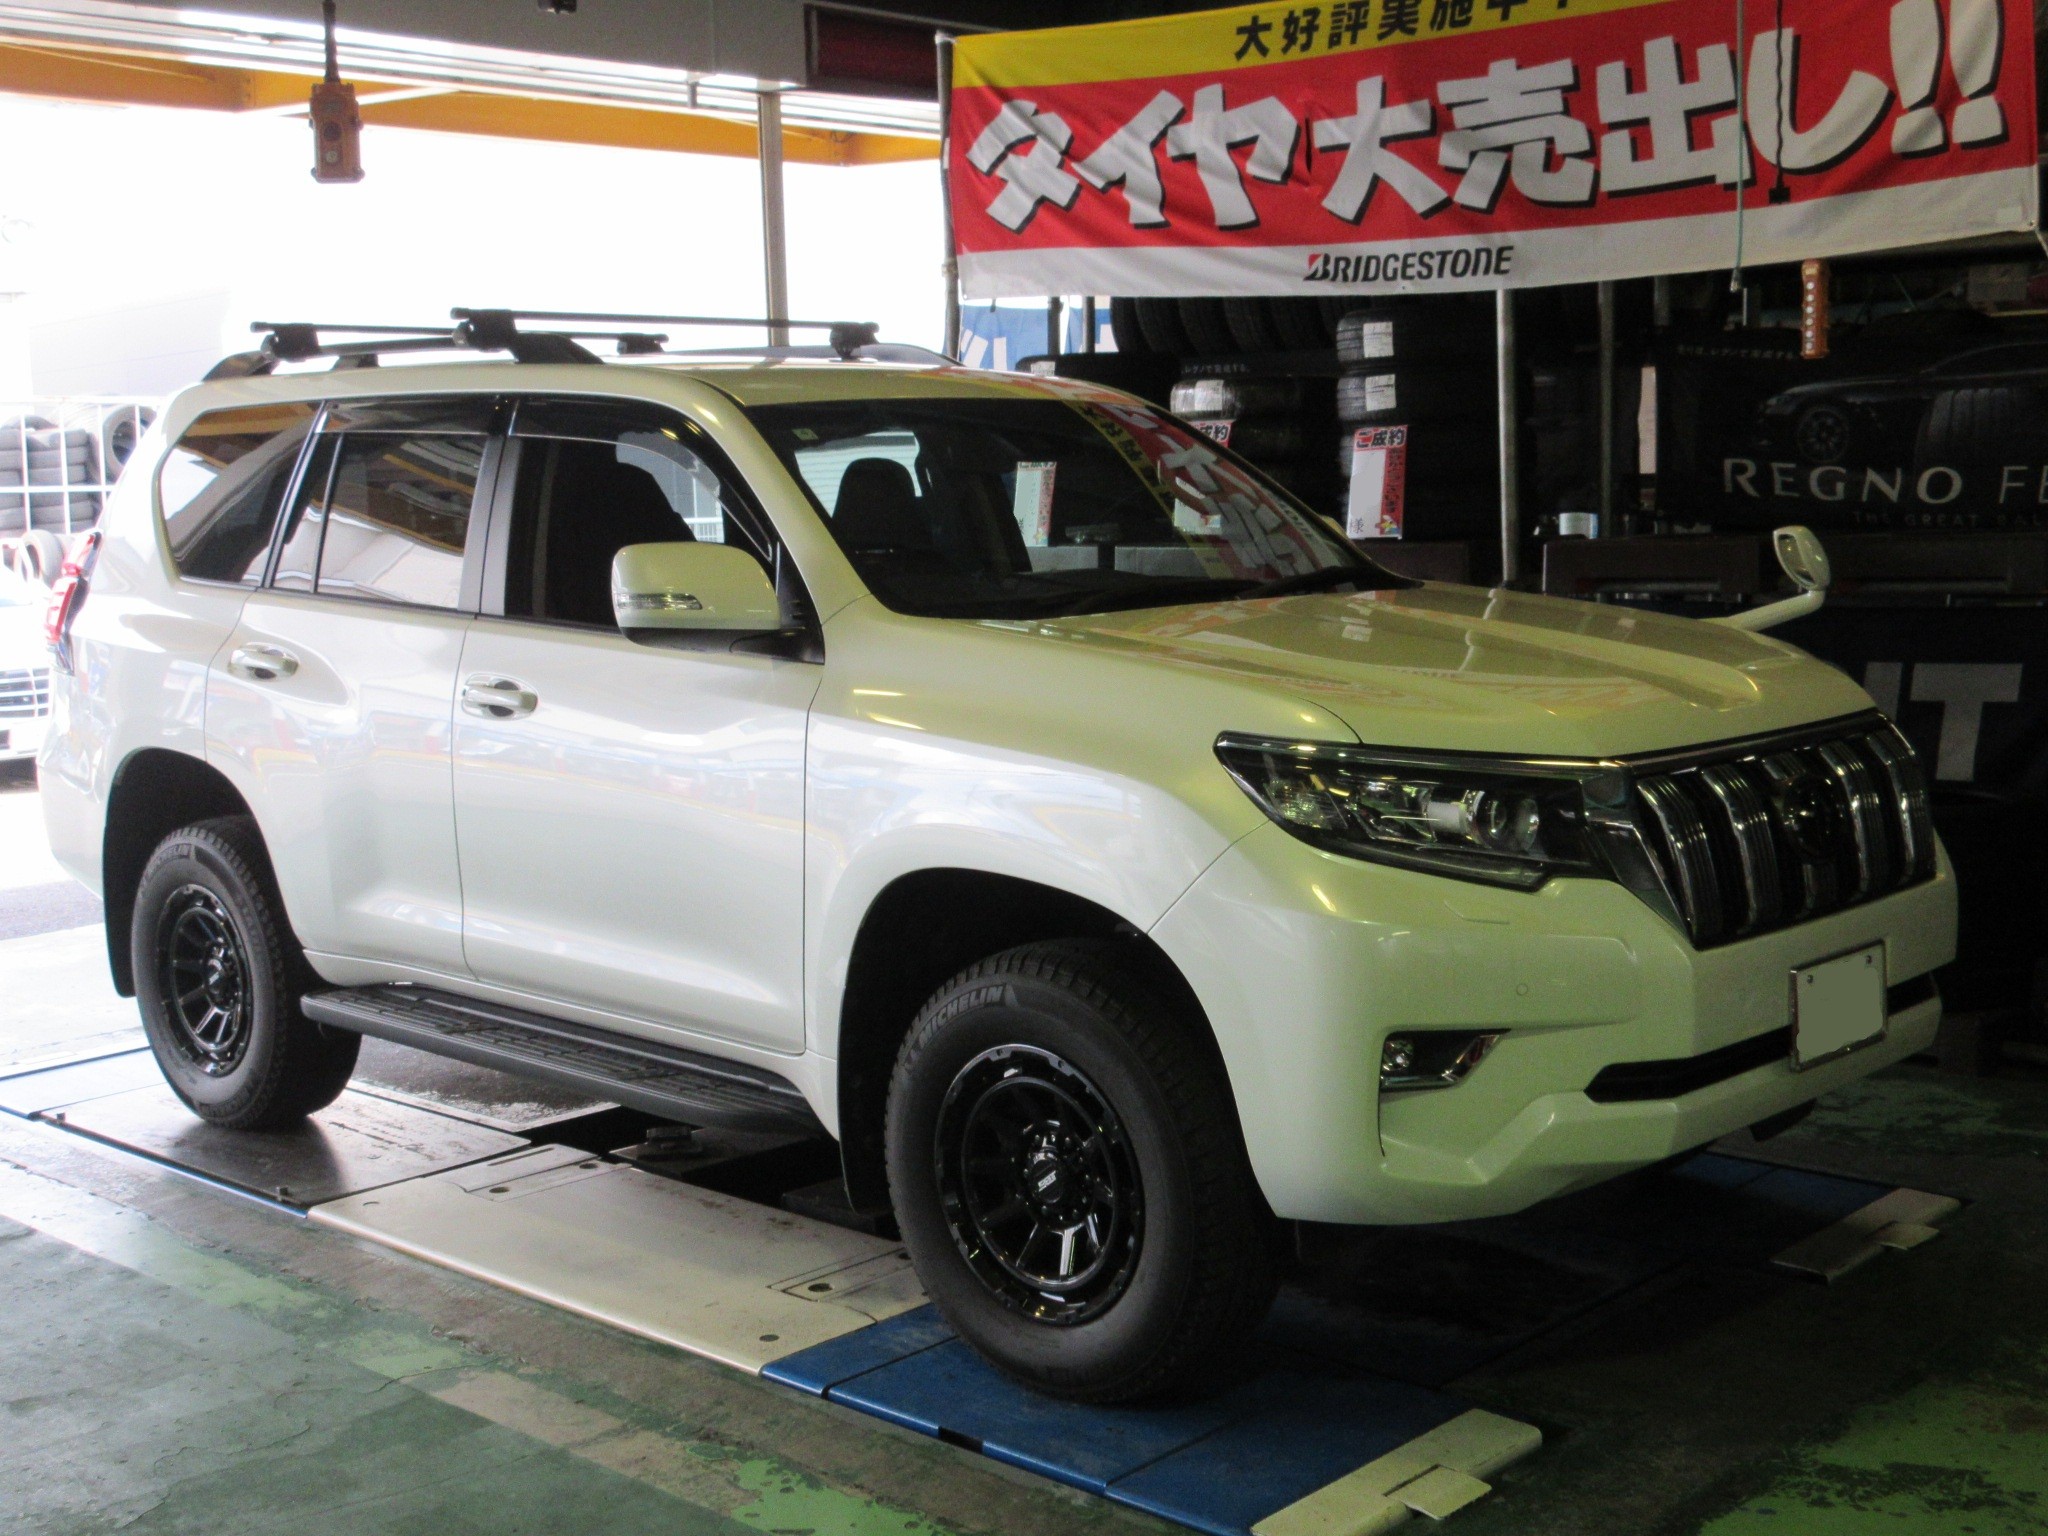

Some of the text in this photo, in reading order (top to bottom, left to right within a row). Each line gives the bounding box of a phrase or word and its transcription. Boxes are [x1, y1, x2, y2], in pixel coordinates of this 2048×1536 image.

[1233, 0, 1572, 60] 大好評実施
[1303, 245, 1514, 282] BRIDGESTONE
[1355, 429, 1405, 449] ご成約
[1722, 457, 1964, 505] REGNO
[1904, 512, 1979, 528] GREAT
[918, 985, 1006, 1050] MICHELIN
